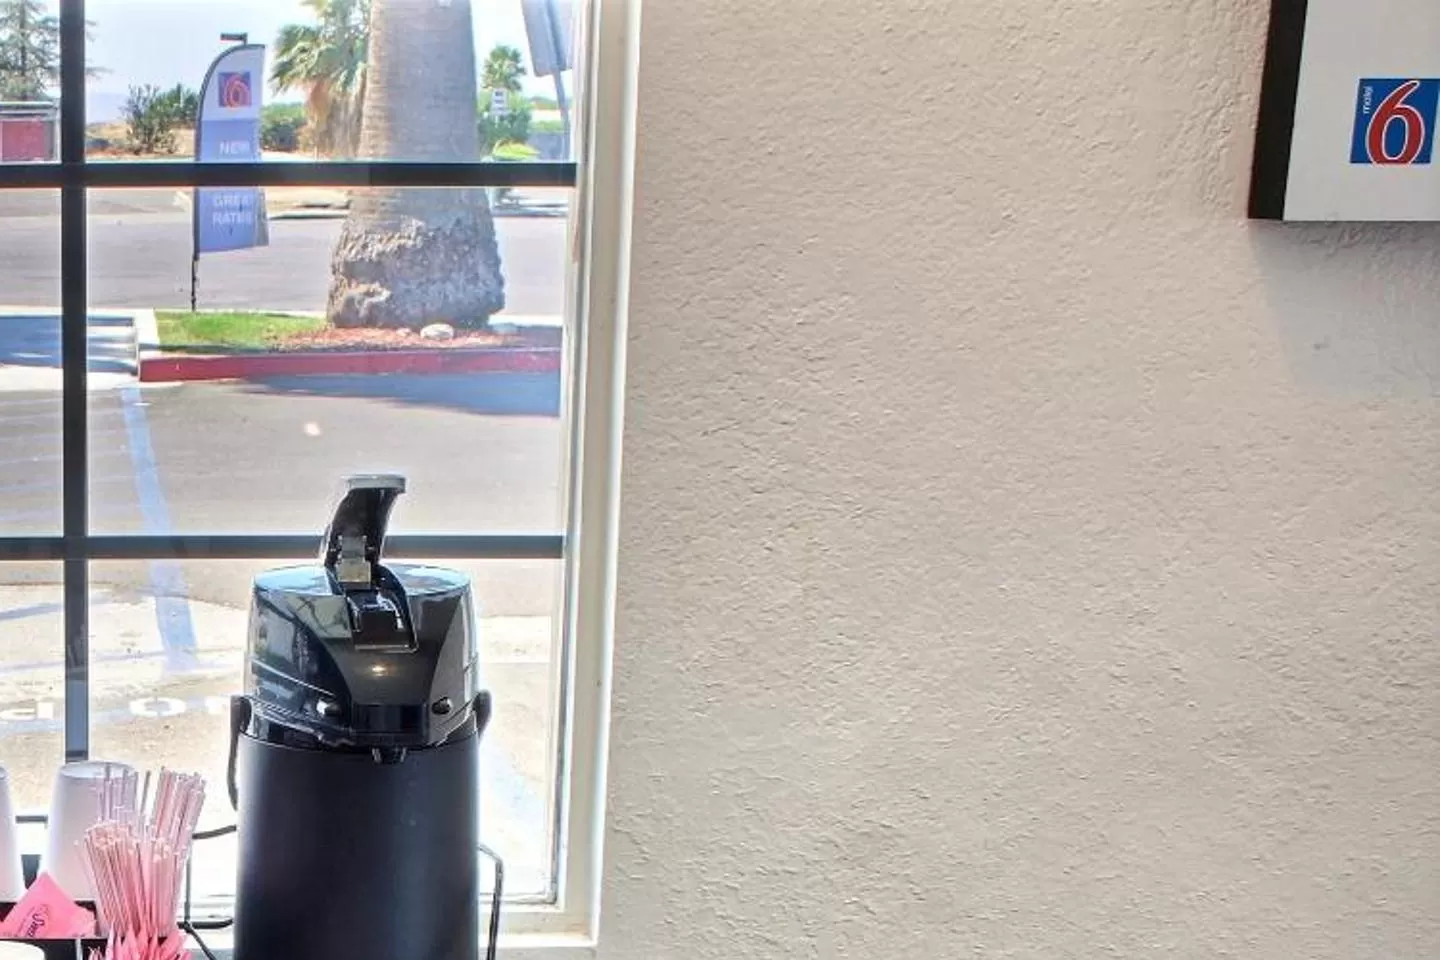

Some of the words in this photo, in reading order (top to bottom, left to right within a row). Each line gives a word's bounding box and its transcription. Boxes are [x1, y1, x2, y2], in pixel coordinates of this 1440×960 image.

[224, 75, 251, 110] 6
[1365, 80, 1425, 168] 6
[213, 194, 251, 208] GRE
